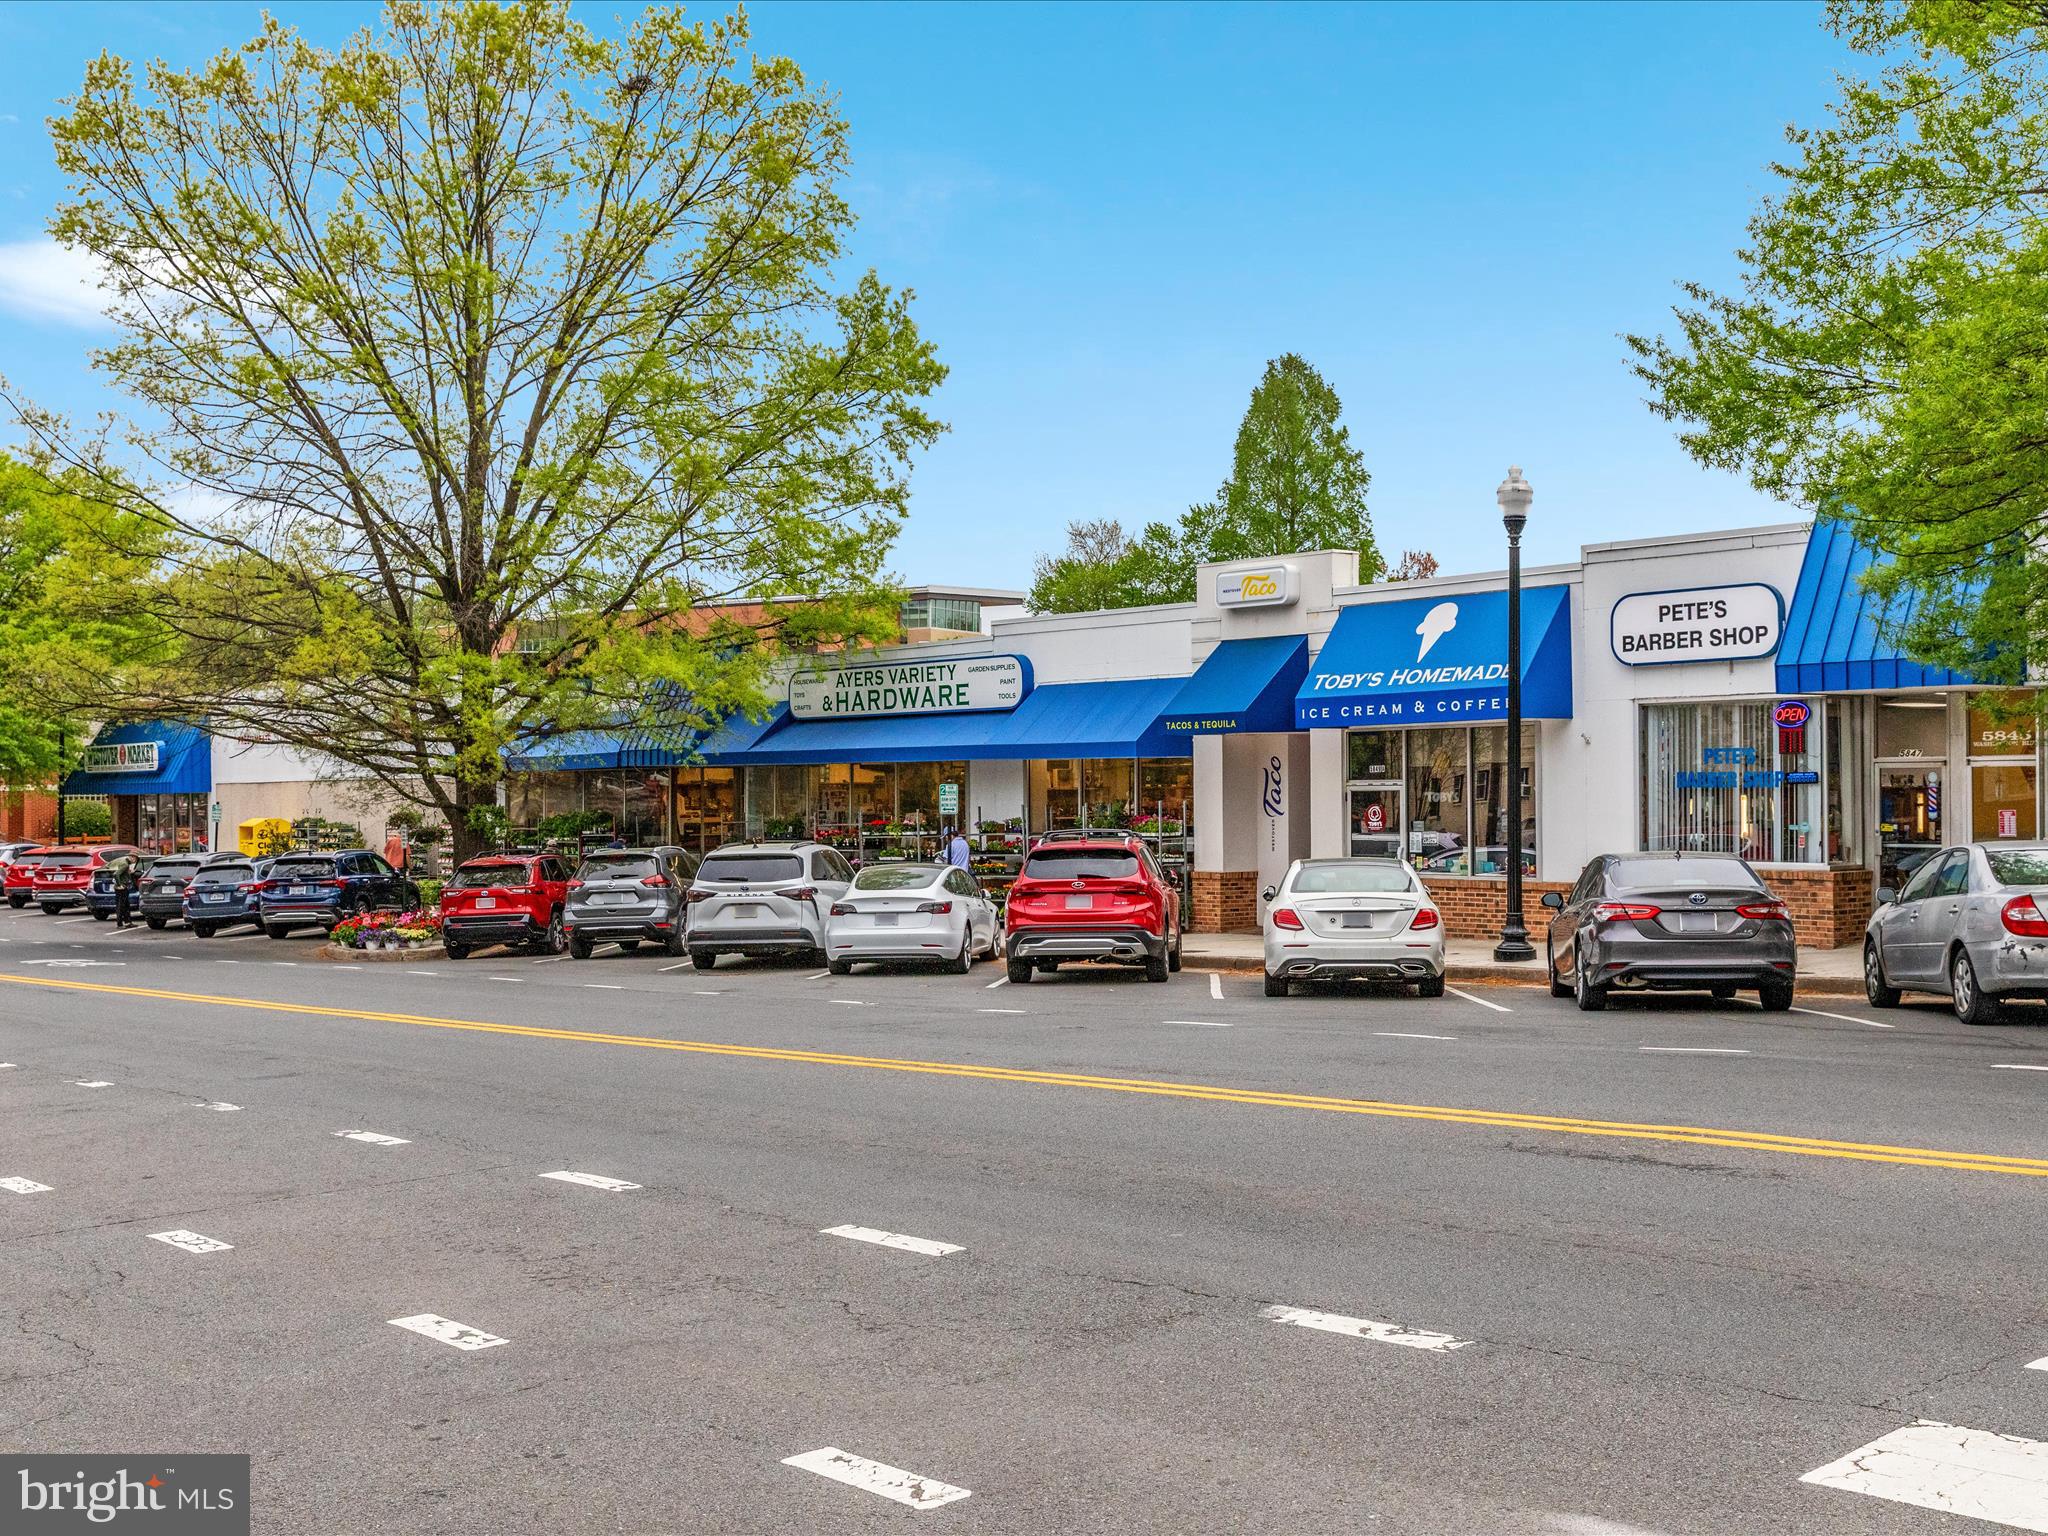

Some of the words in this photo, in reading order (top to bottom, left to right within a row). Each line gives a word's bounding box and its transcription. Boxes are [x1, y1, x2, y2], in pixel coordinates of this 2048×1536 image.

[1241, 575, 1277, 600] Taco
[1659, 600, 1727, 622] PETE'S
[1622, 630, 1703, 653] BARBER
[1709, 625, 1769, 647] SHOP
[836, 669, 884, 688] AYERS
[888, 664, 957, 685] VARIETY
[990, 664, 1016, 672] SUPPLIES
[1314, 672, 1384, 690] TOBY'S
[793, 691, 805, 699] TOYS
[822, 695, 833, 712] &
[836, 683, 970, 712] HARDWARE
[1302, 707, 1329, 719] ICE
[1341, 704, 1402, 717] CREAM
[1414, 701, 1425, 713] &
[1437, 698, 1509, 712] COFFE
[1775, 707, 1806, 721] OPEN
[1166, 721, 1192, 730] TACOS
[1194, 721, 1200, 729] &
[1202, 719, 1237, 729] TEQUILA
[127, 744, 154, 765] MARKET
[1900, 749, 1922, 758] 5847
[1262, 756, 1284, 817] Taco
[1676, 770, 1738, 789] BARBER
[1743, 770, 1786, 789] SHOP
[940, 785, 946, 795] 2
